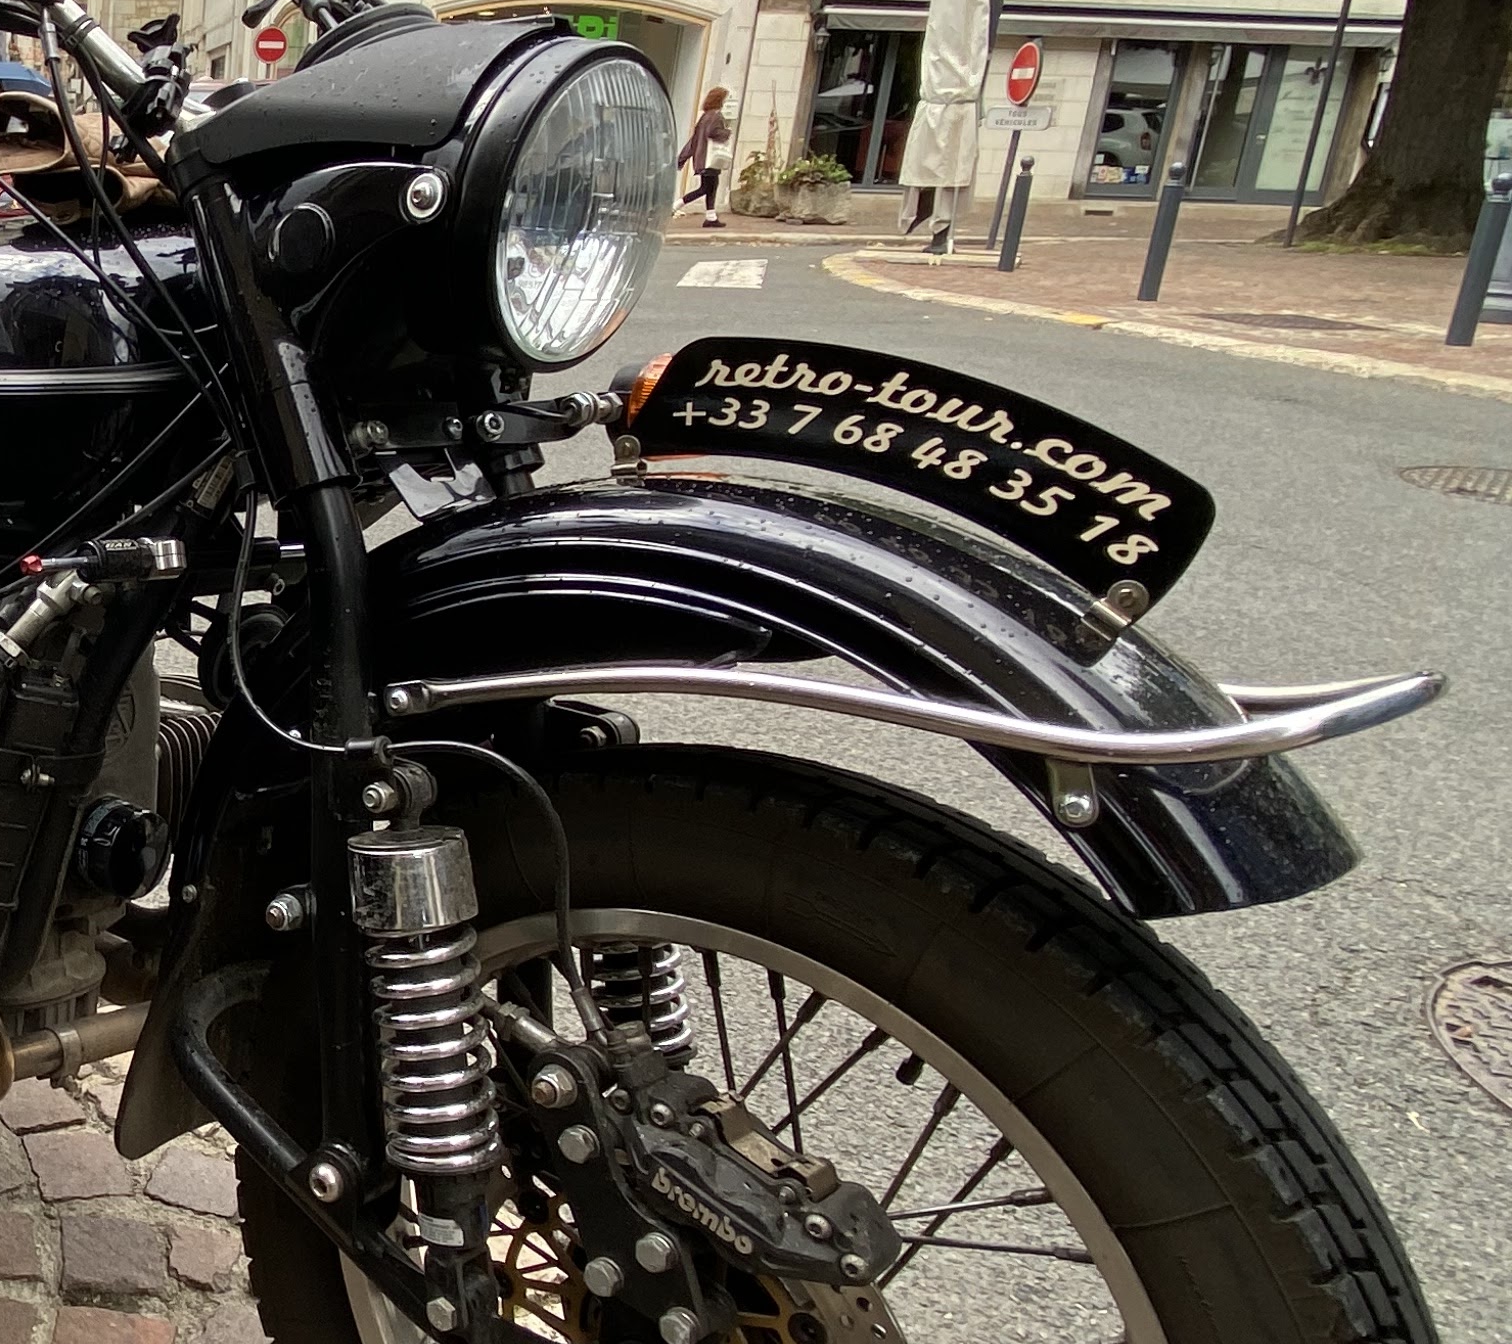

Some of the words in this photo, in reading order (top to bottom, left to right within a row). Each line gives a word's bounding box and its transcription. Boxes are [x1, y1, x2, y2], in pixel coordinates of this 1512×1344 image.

[672, 397, 770, 430] +33
[787, 404, 823, 436] 7
[833, 414, 904, 453] 68
[911, 436, 987, 481] 48
[988, 468, 1076, 517] 35
[1079, 513, 1160, 565] 18
[695, 353, 1174, 522] retro-tour.com
[652, 1167, 753, 1255] brembo
